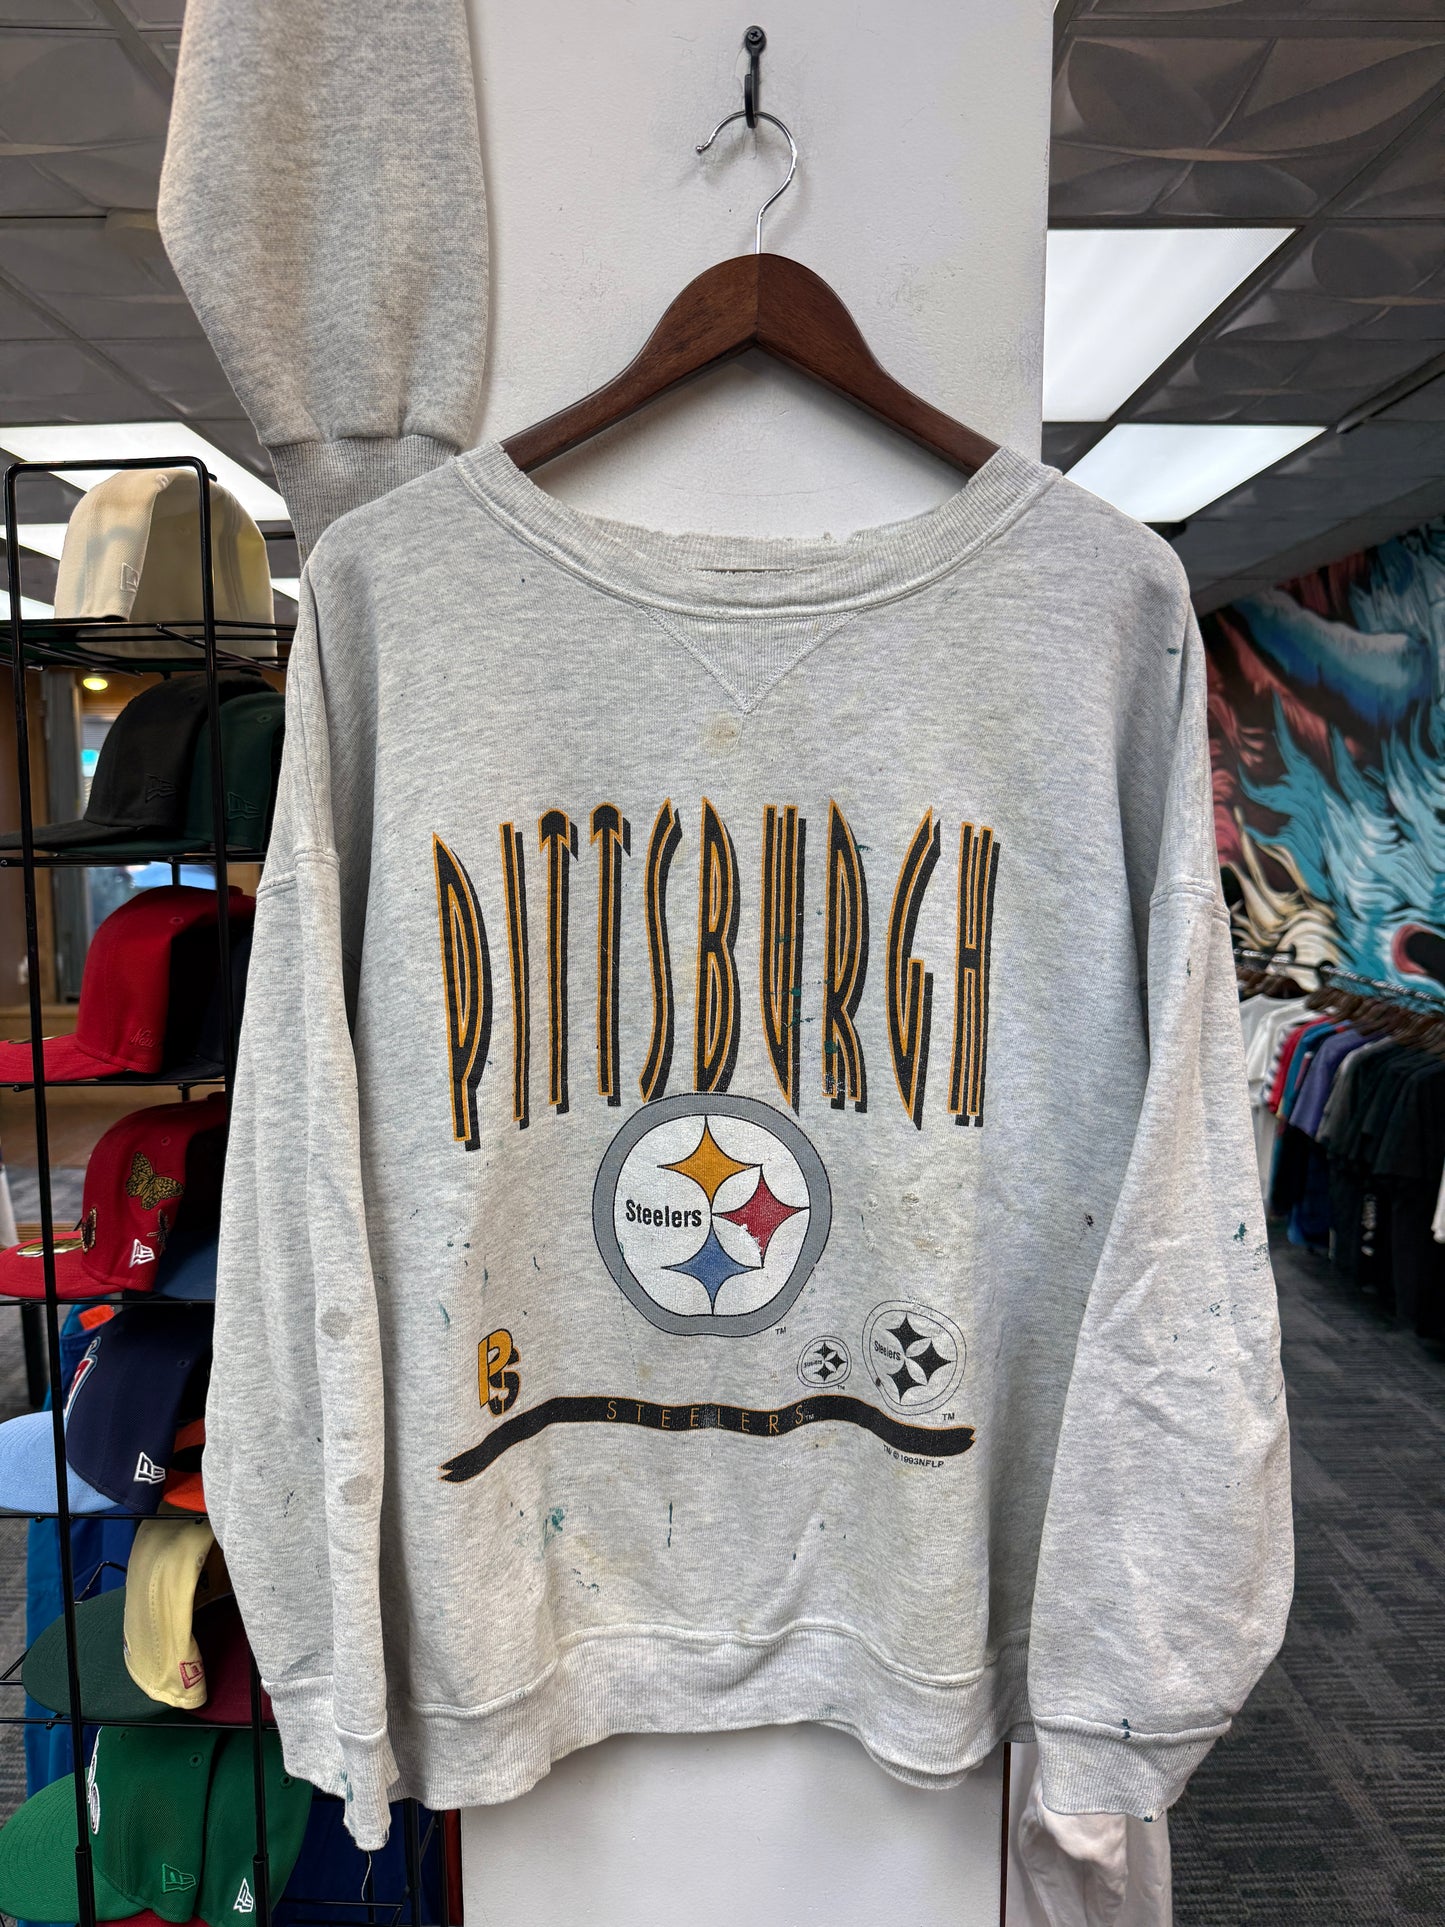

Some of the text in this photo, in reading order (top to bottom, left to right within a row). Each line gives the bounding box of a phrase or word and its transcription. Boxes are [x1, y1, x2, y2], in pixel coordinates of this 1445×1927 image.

[432, 797, 1000, 1152] PITTSBURGH
[625, 1199, 702, 1228] Steelers
[775, 1327, 787, 1335] TM
[874, 1340, 901, 1361] Steelers
[606, 1401, 804, 1434] STEELERS
[942, 1412, 955, 1420] TM
